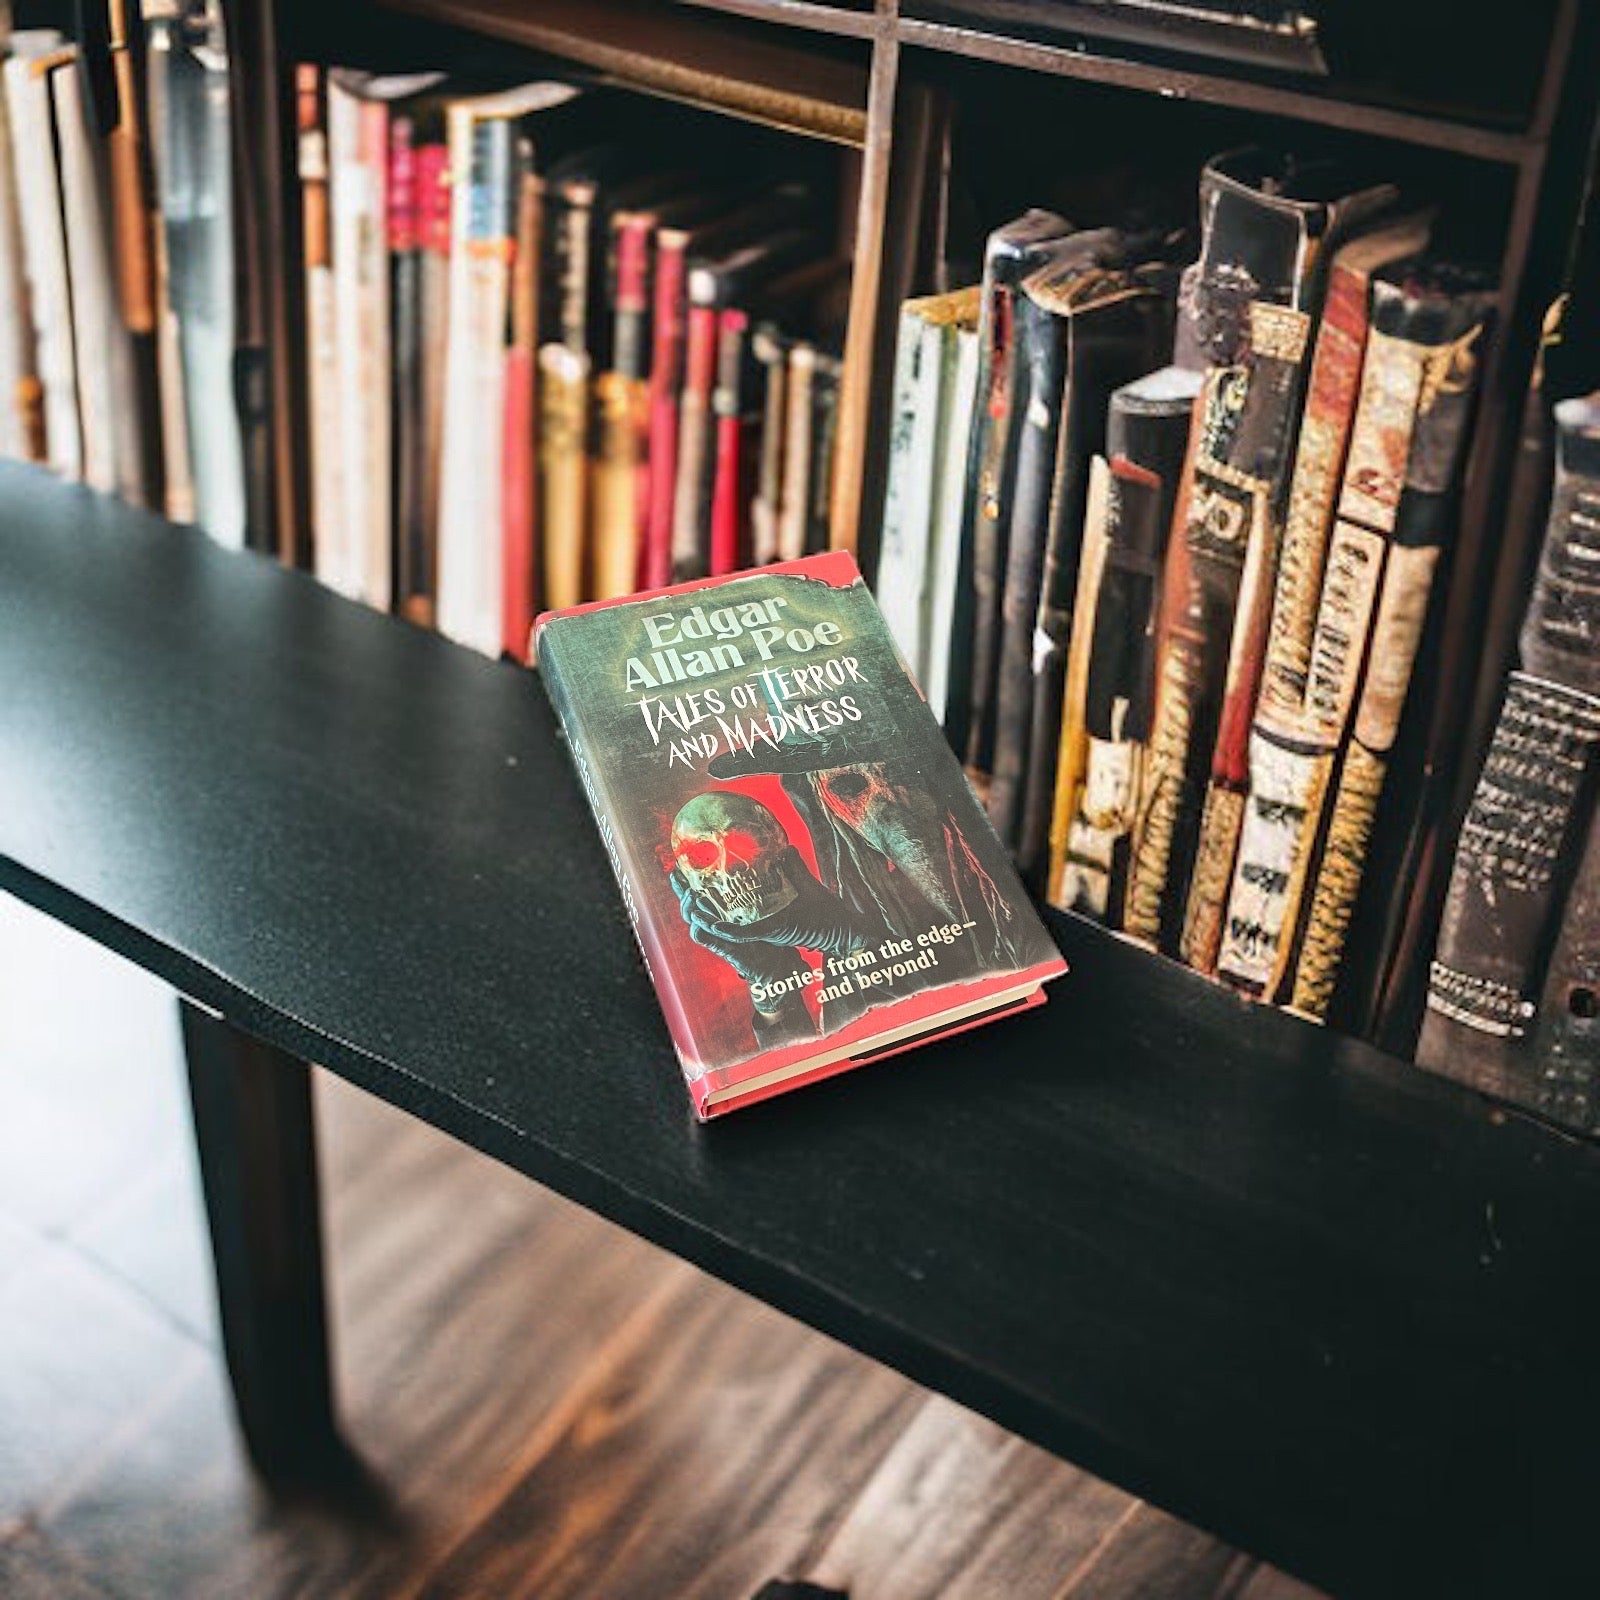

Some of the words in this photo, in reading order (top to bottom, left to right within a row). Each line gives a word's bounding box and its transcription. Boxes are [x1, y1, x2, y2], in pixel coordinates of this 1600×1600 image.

[641, 596, 788, 649] Edgar
[625, 642, 745, 693] Allan
[750, 620, 844, 661] Poe
[624, 688, 726, 746] TALES
[730, 683, 758, 708] OF
[747, 656, 869, 713] TERROR
[669, 730, 719, 770] AND
[714, 696, 862, 758] MADNESS
[600, 814, 622, 874] Allan
[750, 966, 825, 1002] Stories
[826, 951, 878, 977] from
[879, 935, 914, 960] the
[815, 975, 855, 1004] and
[855, 948, 940, 986] beyond!
